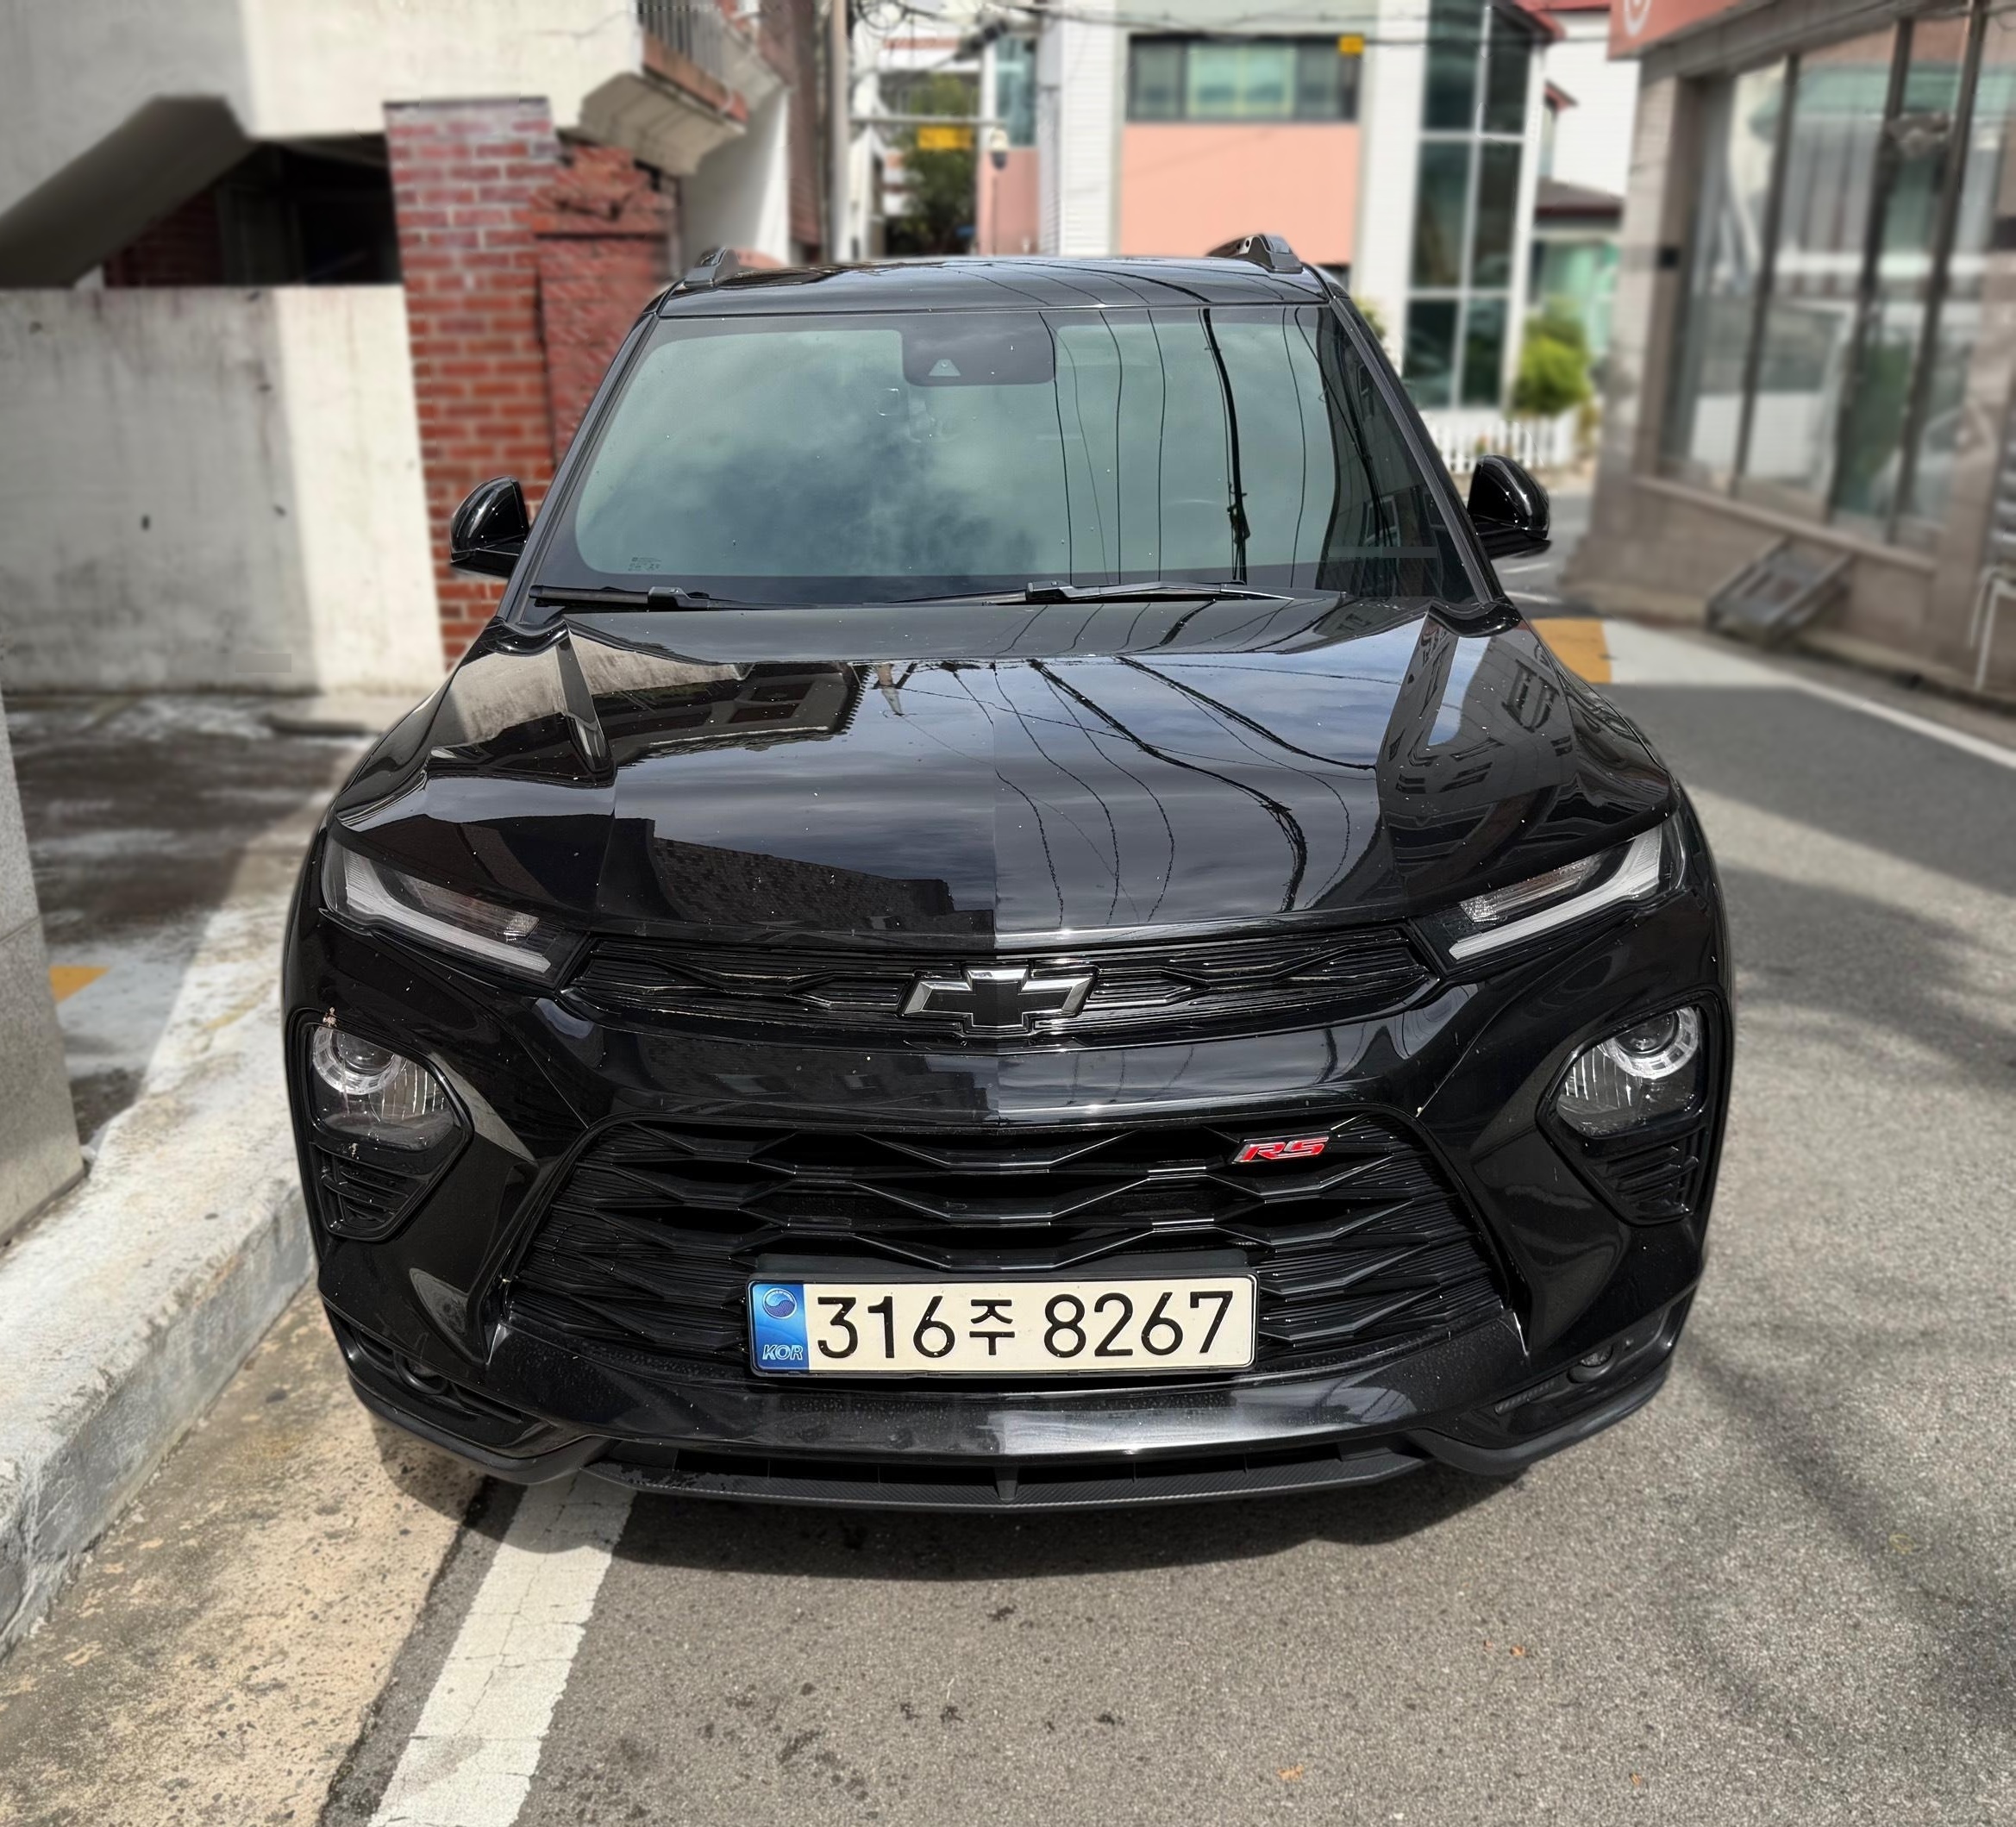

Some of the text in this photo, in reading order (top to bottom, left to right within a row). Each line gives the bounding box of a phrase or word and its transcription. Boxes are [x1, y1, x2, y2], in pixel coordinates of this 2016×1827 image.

[1233, 1136, 1330, 1162] RS
[817, 1291, 1234, 1359] 316주 8267
[761, 1344, 803, 1360] KOR
